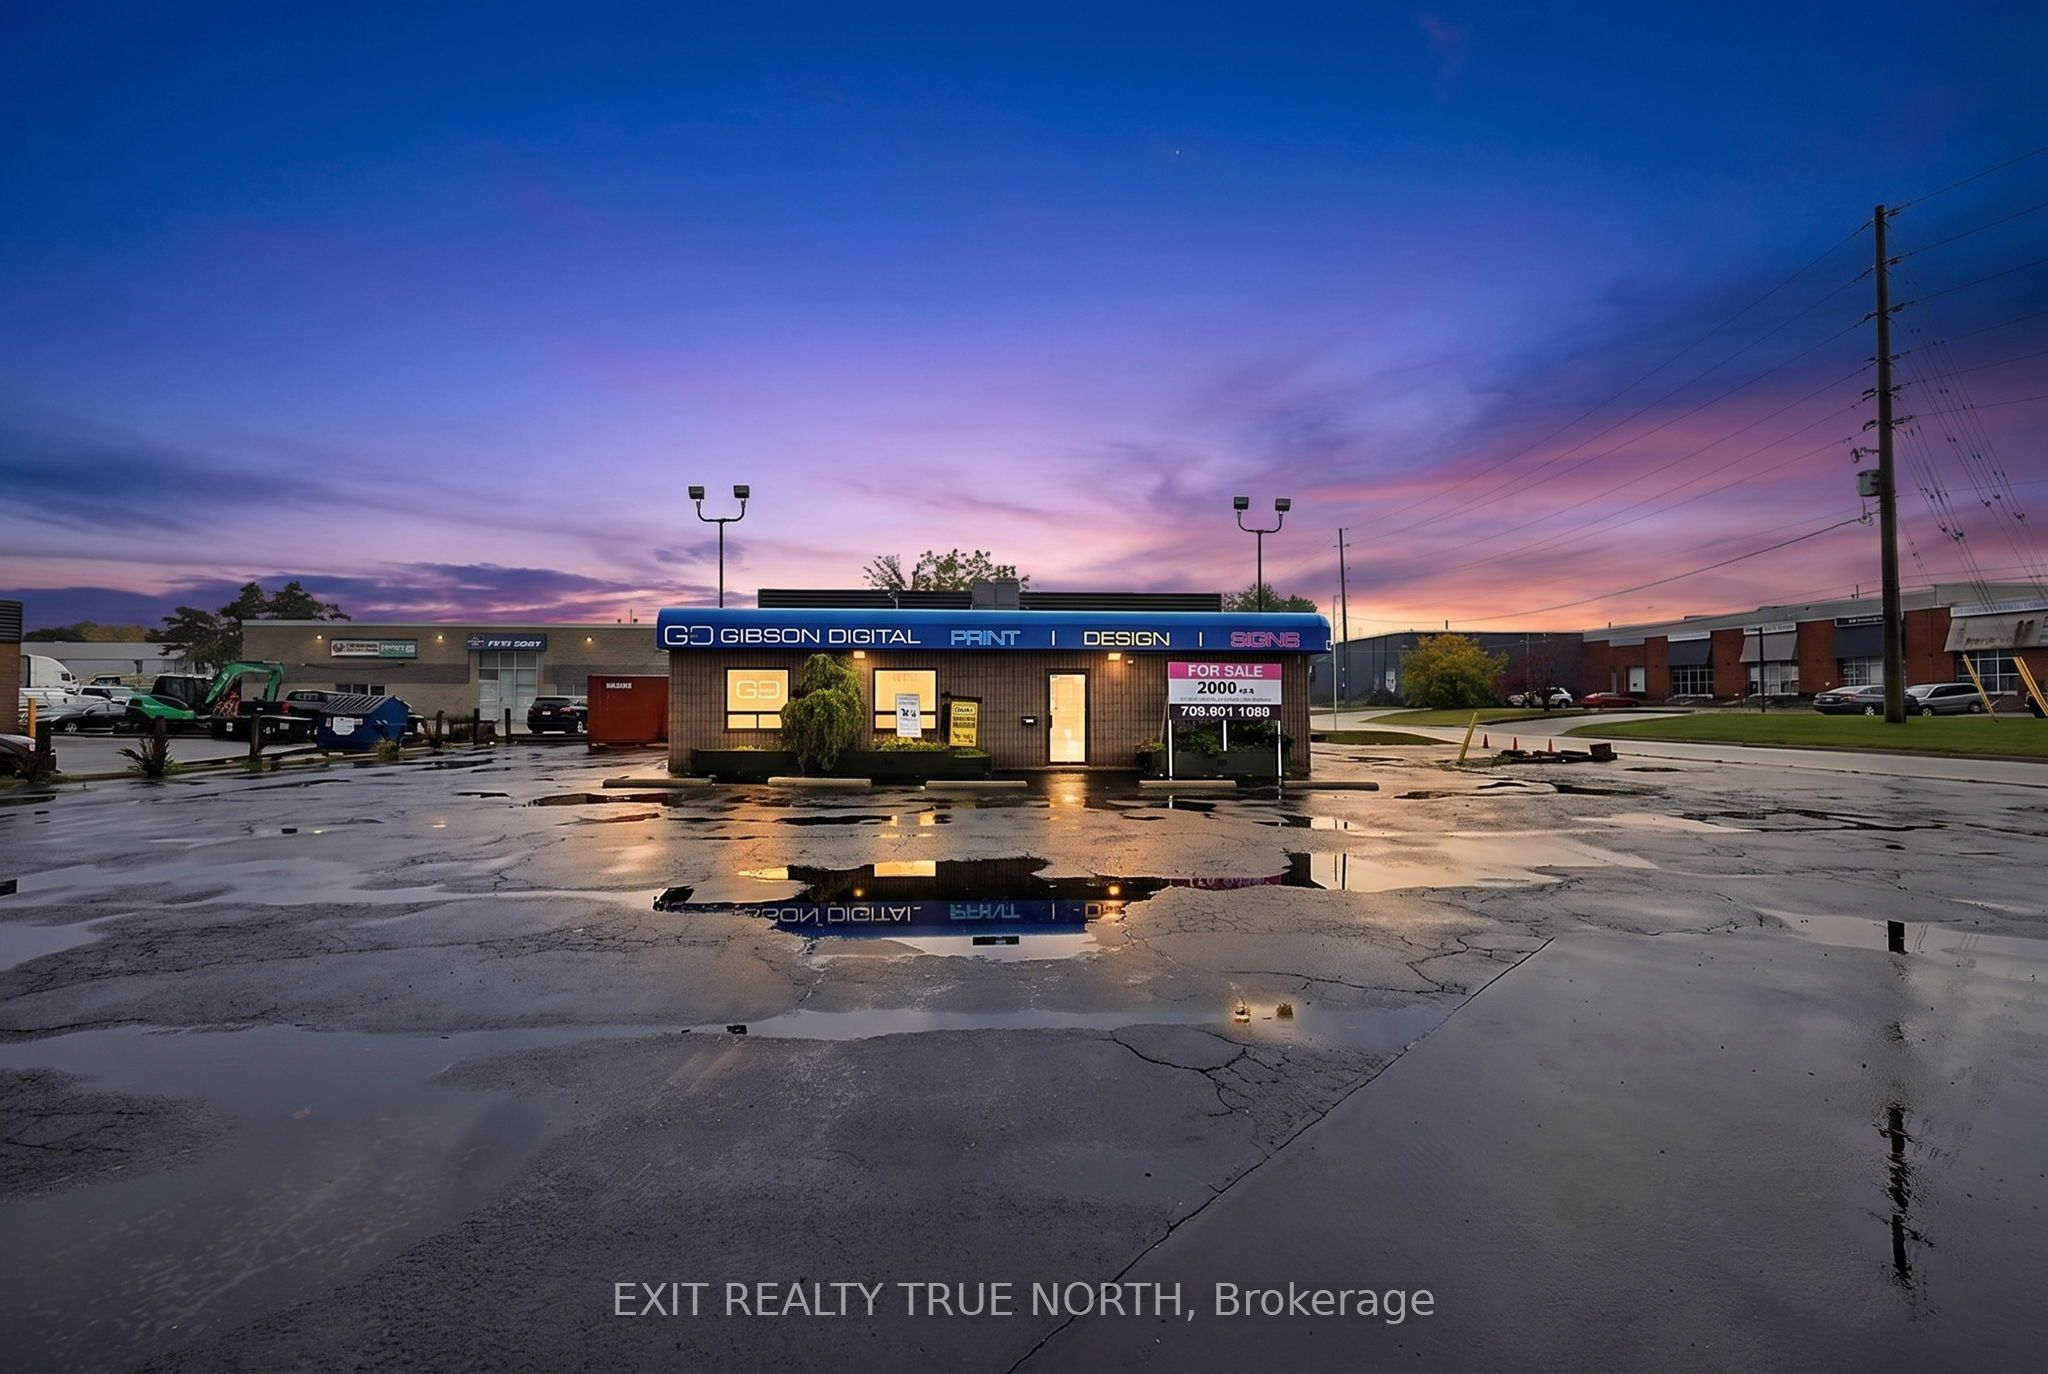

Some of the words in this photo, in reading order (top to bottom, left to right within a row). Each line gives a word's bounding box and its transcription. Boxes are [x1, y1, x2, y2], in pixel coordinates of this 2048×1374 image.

[720, 628, 820, 644] GIBSON
[828, 628, 921, 644] DIGITAL
[950, 629, 1021, 647] PRINT
[1083, 630, 1170, 647] DESIGN
[1230, 631, 1300, 648] SIGNS
[1188, 664, 1220, 677] FOR
[1224, 665, 1263, 678] SALE
[1197, 681, 1237, 695] 2000
